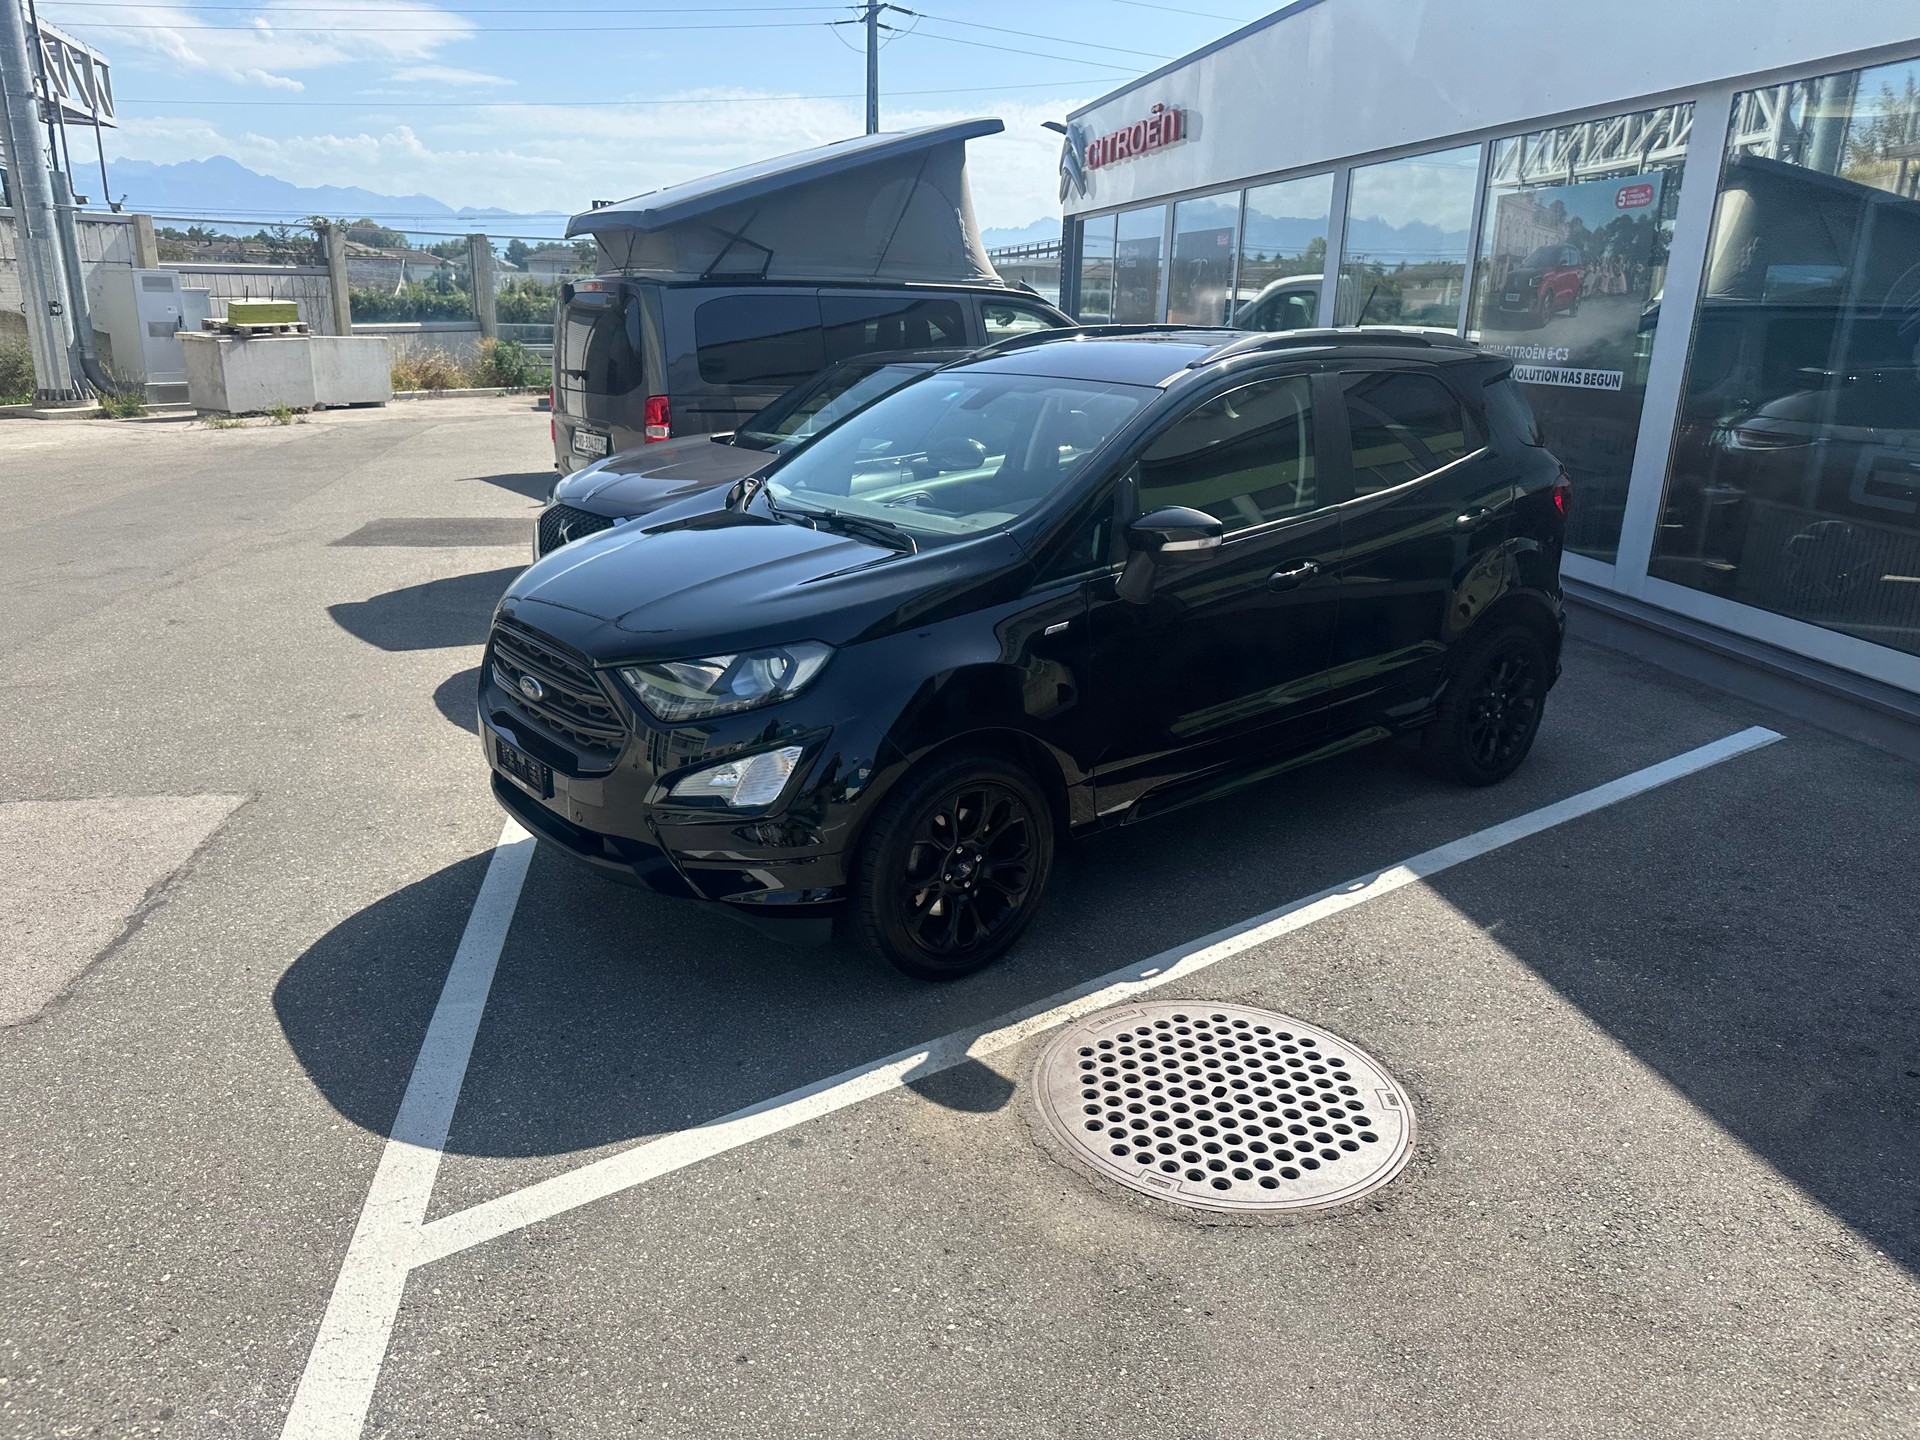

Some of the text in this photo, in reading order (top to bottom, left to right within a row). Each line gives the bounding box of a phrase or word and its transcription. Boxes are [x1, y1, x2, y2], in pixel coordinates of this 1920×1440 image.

[1618, 190, 1627, 207] 5
[1547, 347, 1569, 360] ë-C3
[1511, 368, 1621, 388] VOLUTION HAS BEGUN
